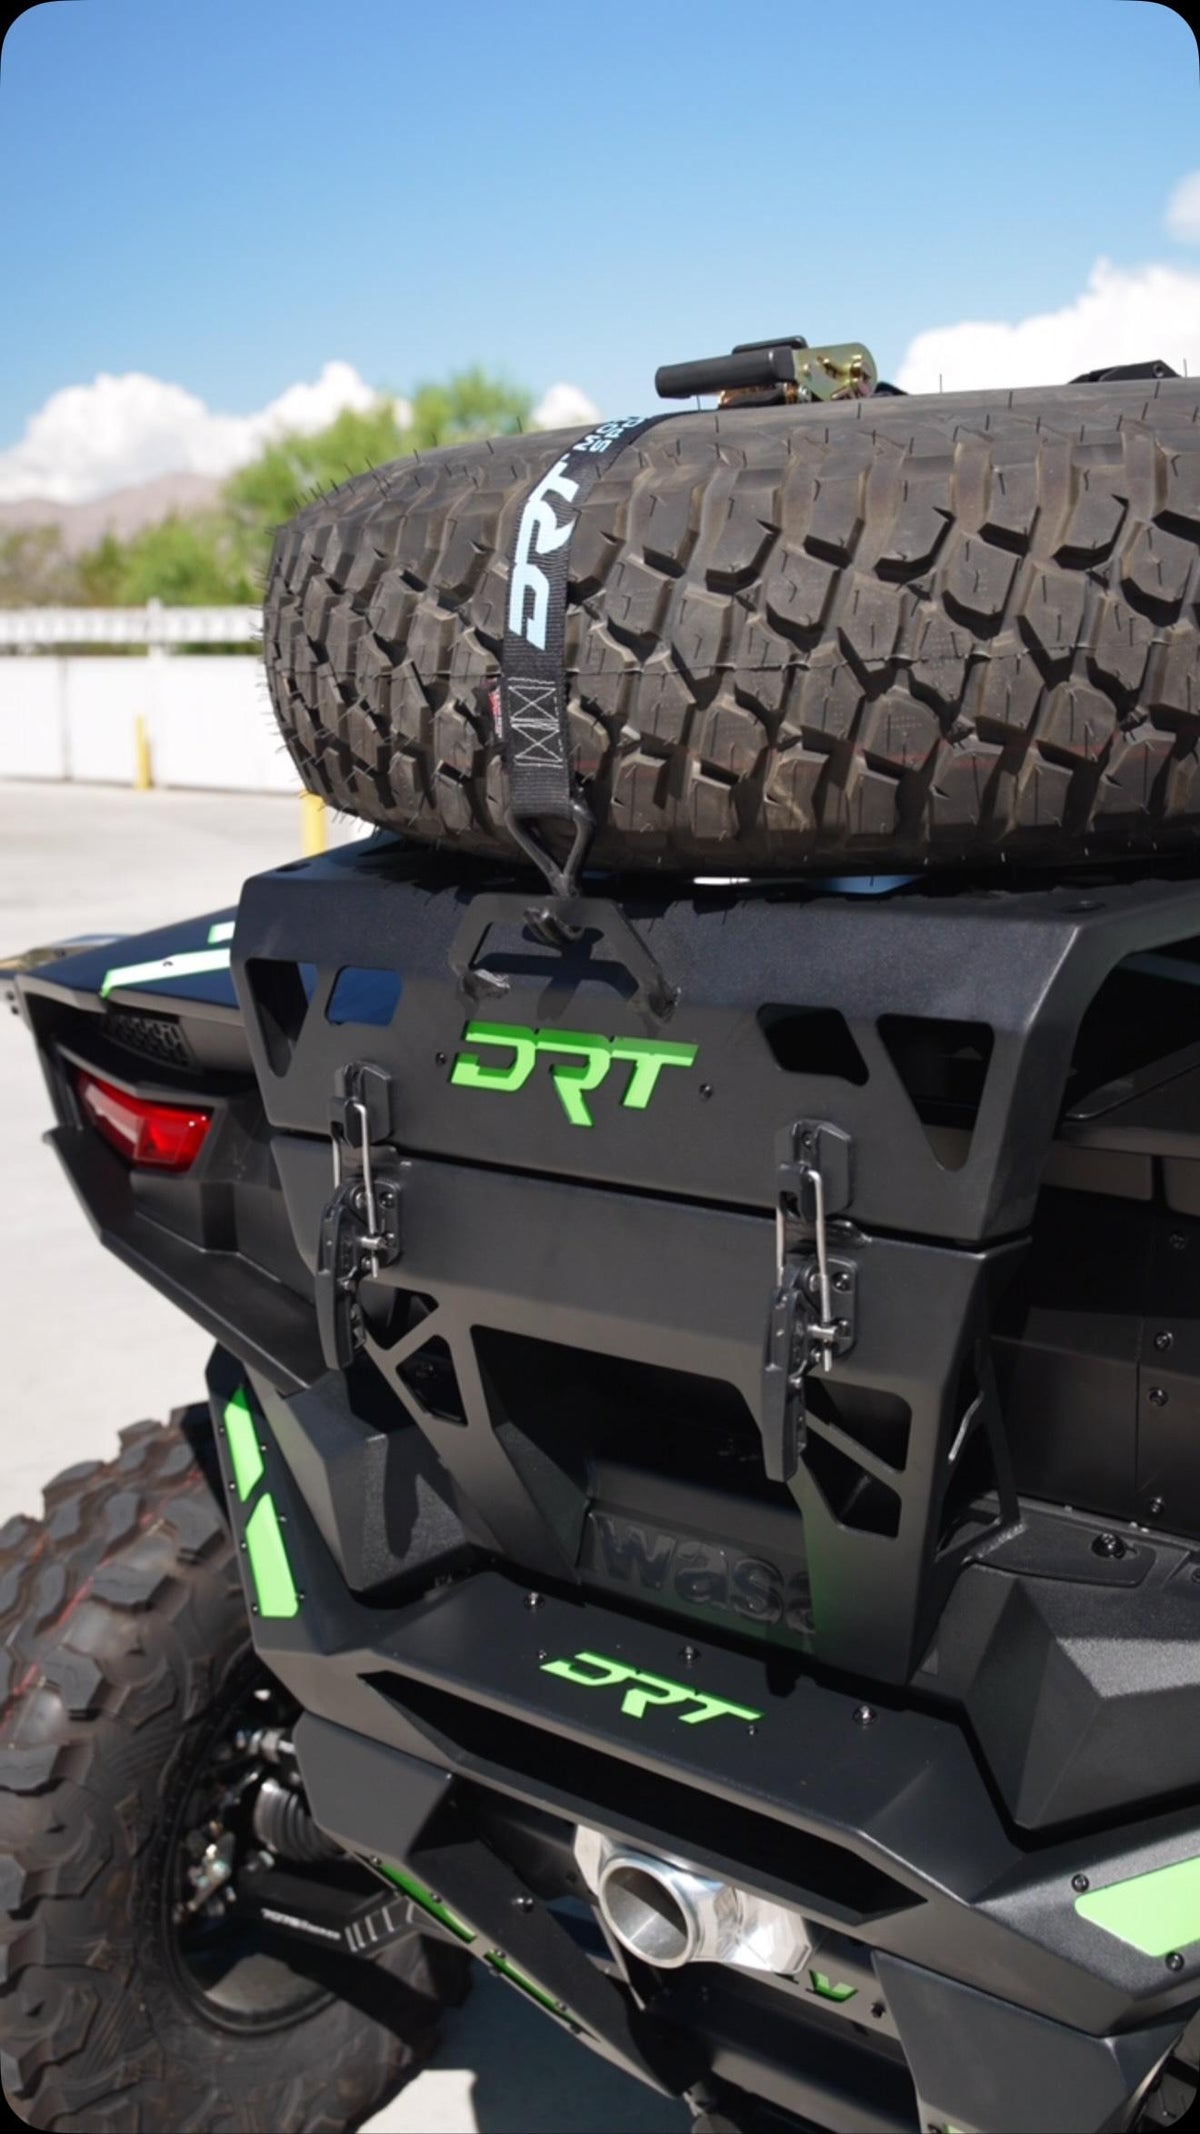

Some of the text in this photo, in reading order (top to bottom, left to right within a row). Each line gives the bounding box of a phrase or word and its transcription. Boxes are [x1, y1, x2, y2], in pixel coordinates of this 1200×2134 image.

[508, 453, 580, 650] DRT
[451, 1020, 699, 1126] DRT
[539, 1652, 764, 1724] DRT
